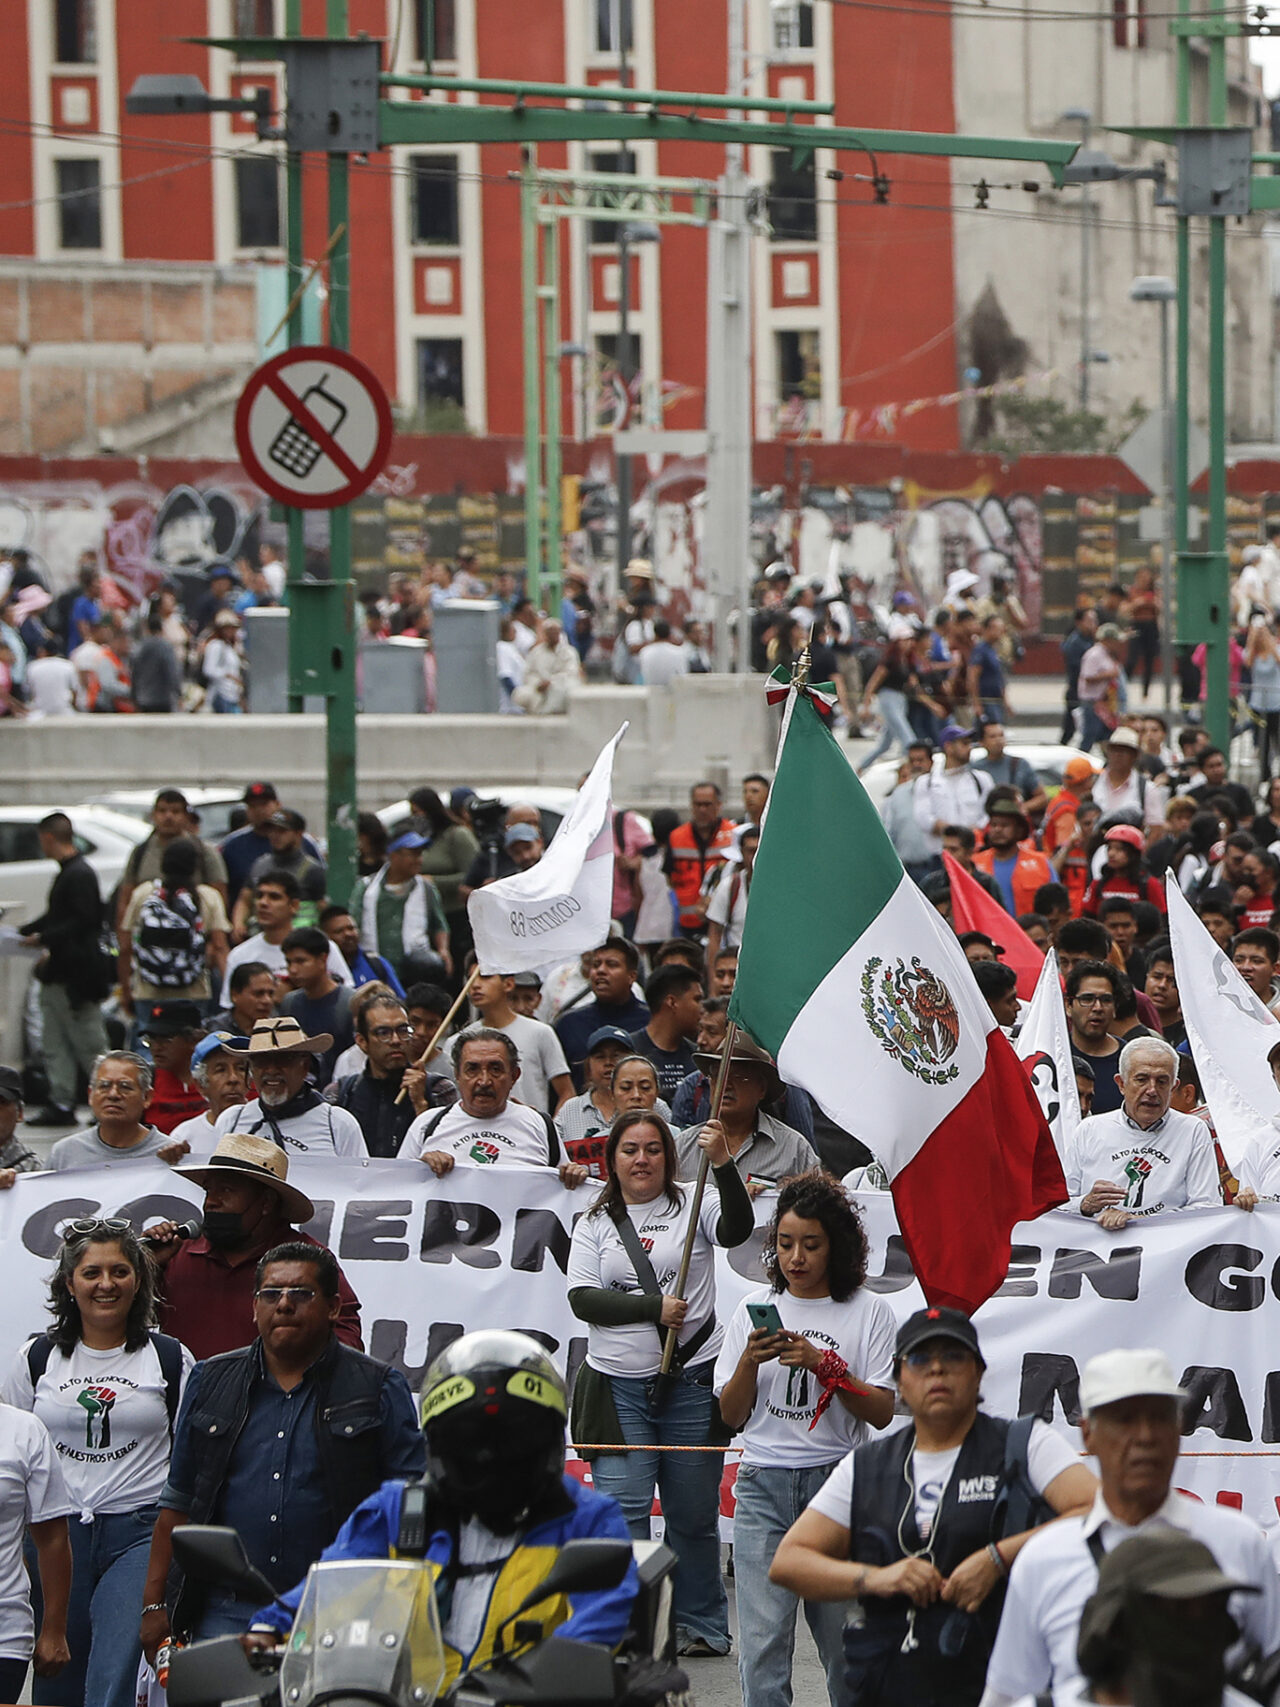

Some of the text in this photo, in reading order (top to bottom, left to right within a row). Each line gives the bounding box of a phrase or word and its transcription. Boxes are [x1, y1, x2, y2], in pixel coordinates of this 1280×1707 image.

[452, 1135, 470, 1149] ALTO
[1111, 1149, 1129, 1161] ALTO
[59, 1378, 81, 1392] ALTO
[84, 1376, 94, 1384] AL
[525, 1377, 542, 1397] 01
[55, 1439, 138, 1463] DE NUESTROS PUEBLOS
[959, 1475, 996, 1494] MVS
